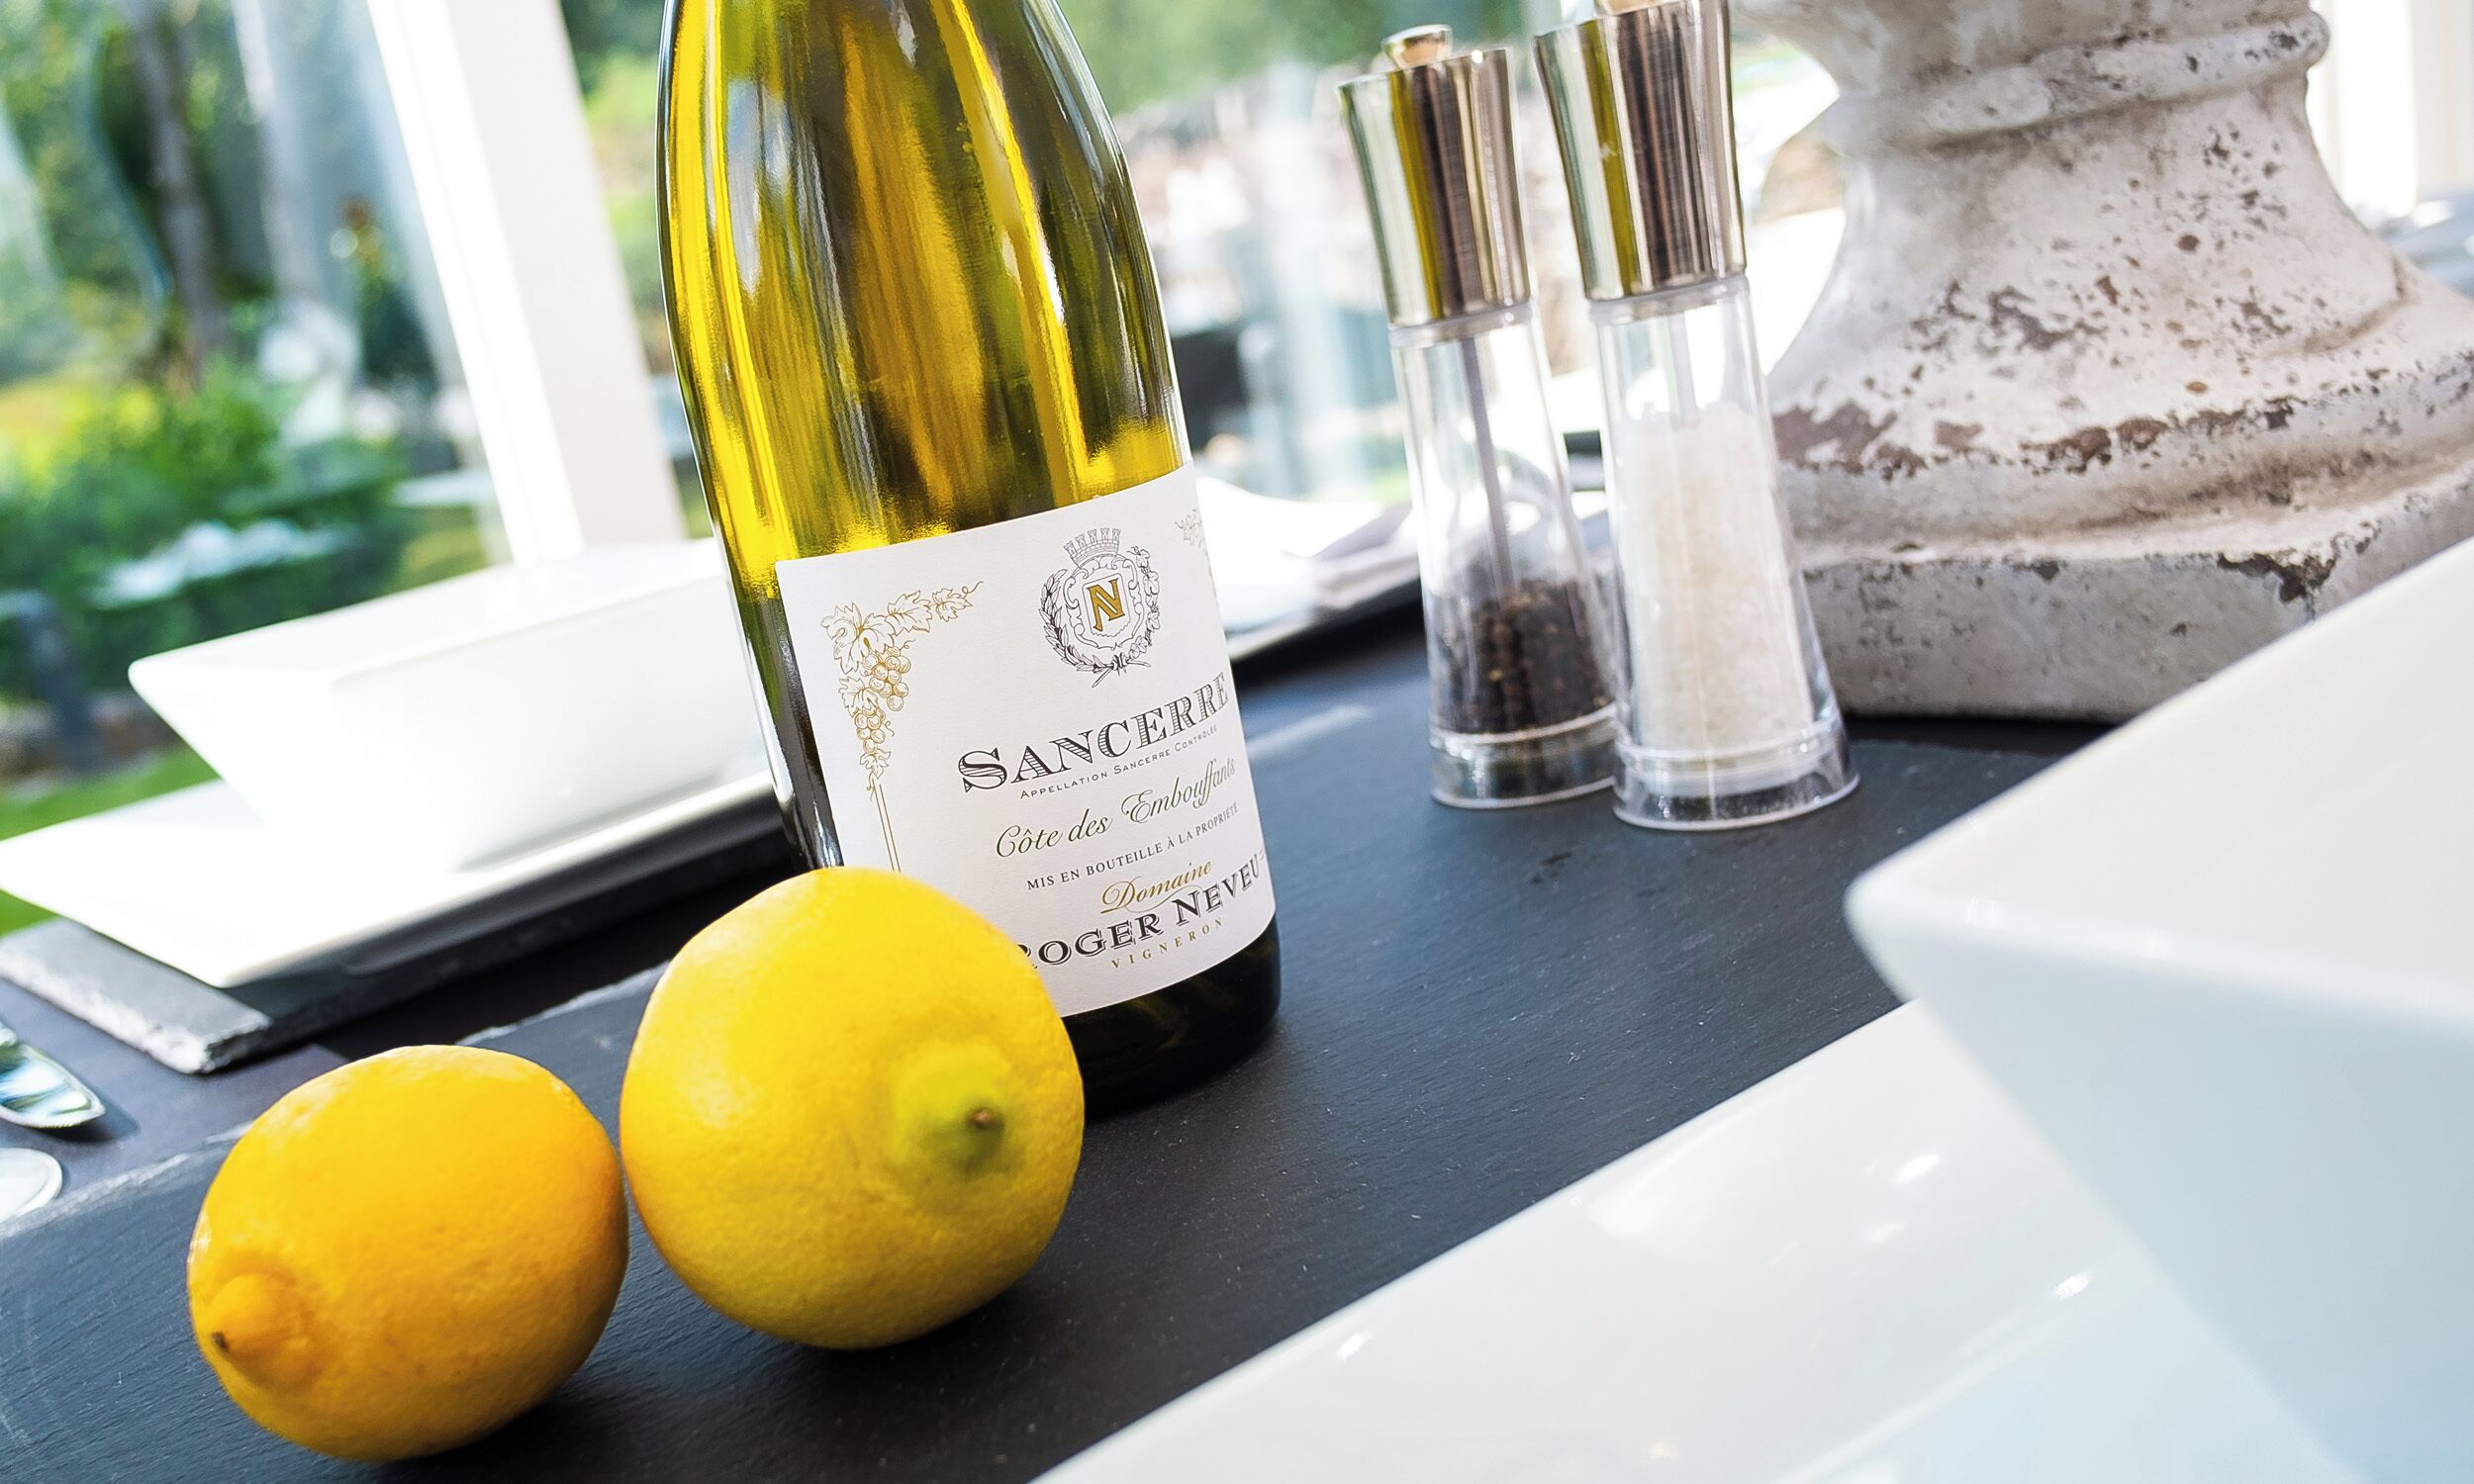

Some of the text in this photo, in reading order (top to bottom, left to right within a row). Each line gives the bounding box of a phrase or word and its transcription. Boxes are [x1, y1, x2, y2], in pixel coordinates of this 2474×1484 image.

[958, 672, 1229, 792] SANCERRE
[1020, 771, 1108, 799] APPELLATION
[1113, 749, 1172, 775] SANCERRE
[996, 758, 1236, 858] Côte des Embouffants
[1027, 875, 1055, 890] MIS
[1061, 869, 1080, 883] EN
[1086, 843, 1163, 877] BOUTEILLE
[1167, 836, 1176, 850] À
[1179, 831, 1193, 844] LA
[1100, 860, 1212, 913] Domaine
[1111, 917, 1223, 970] VIGNERON
